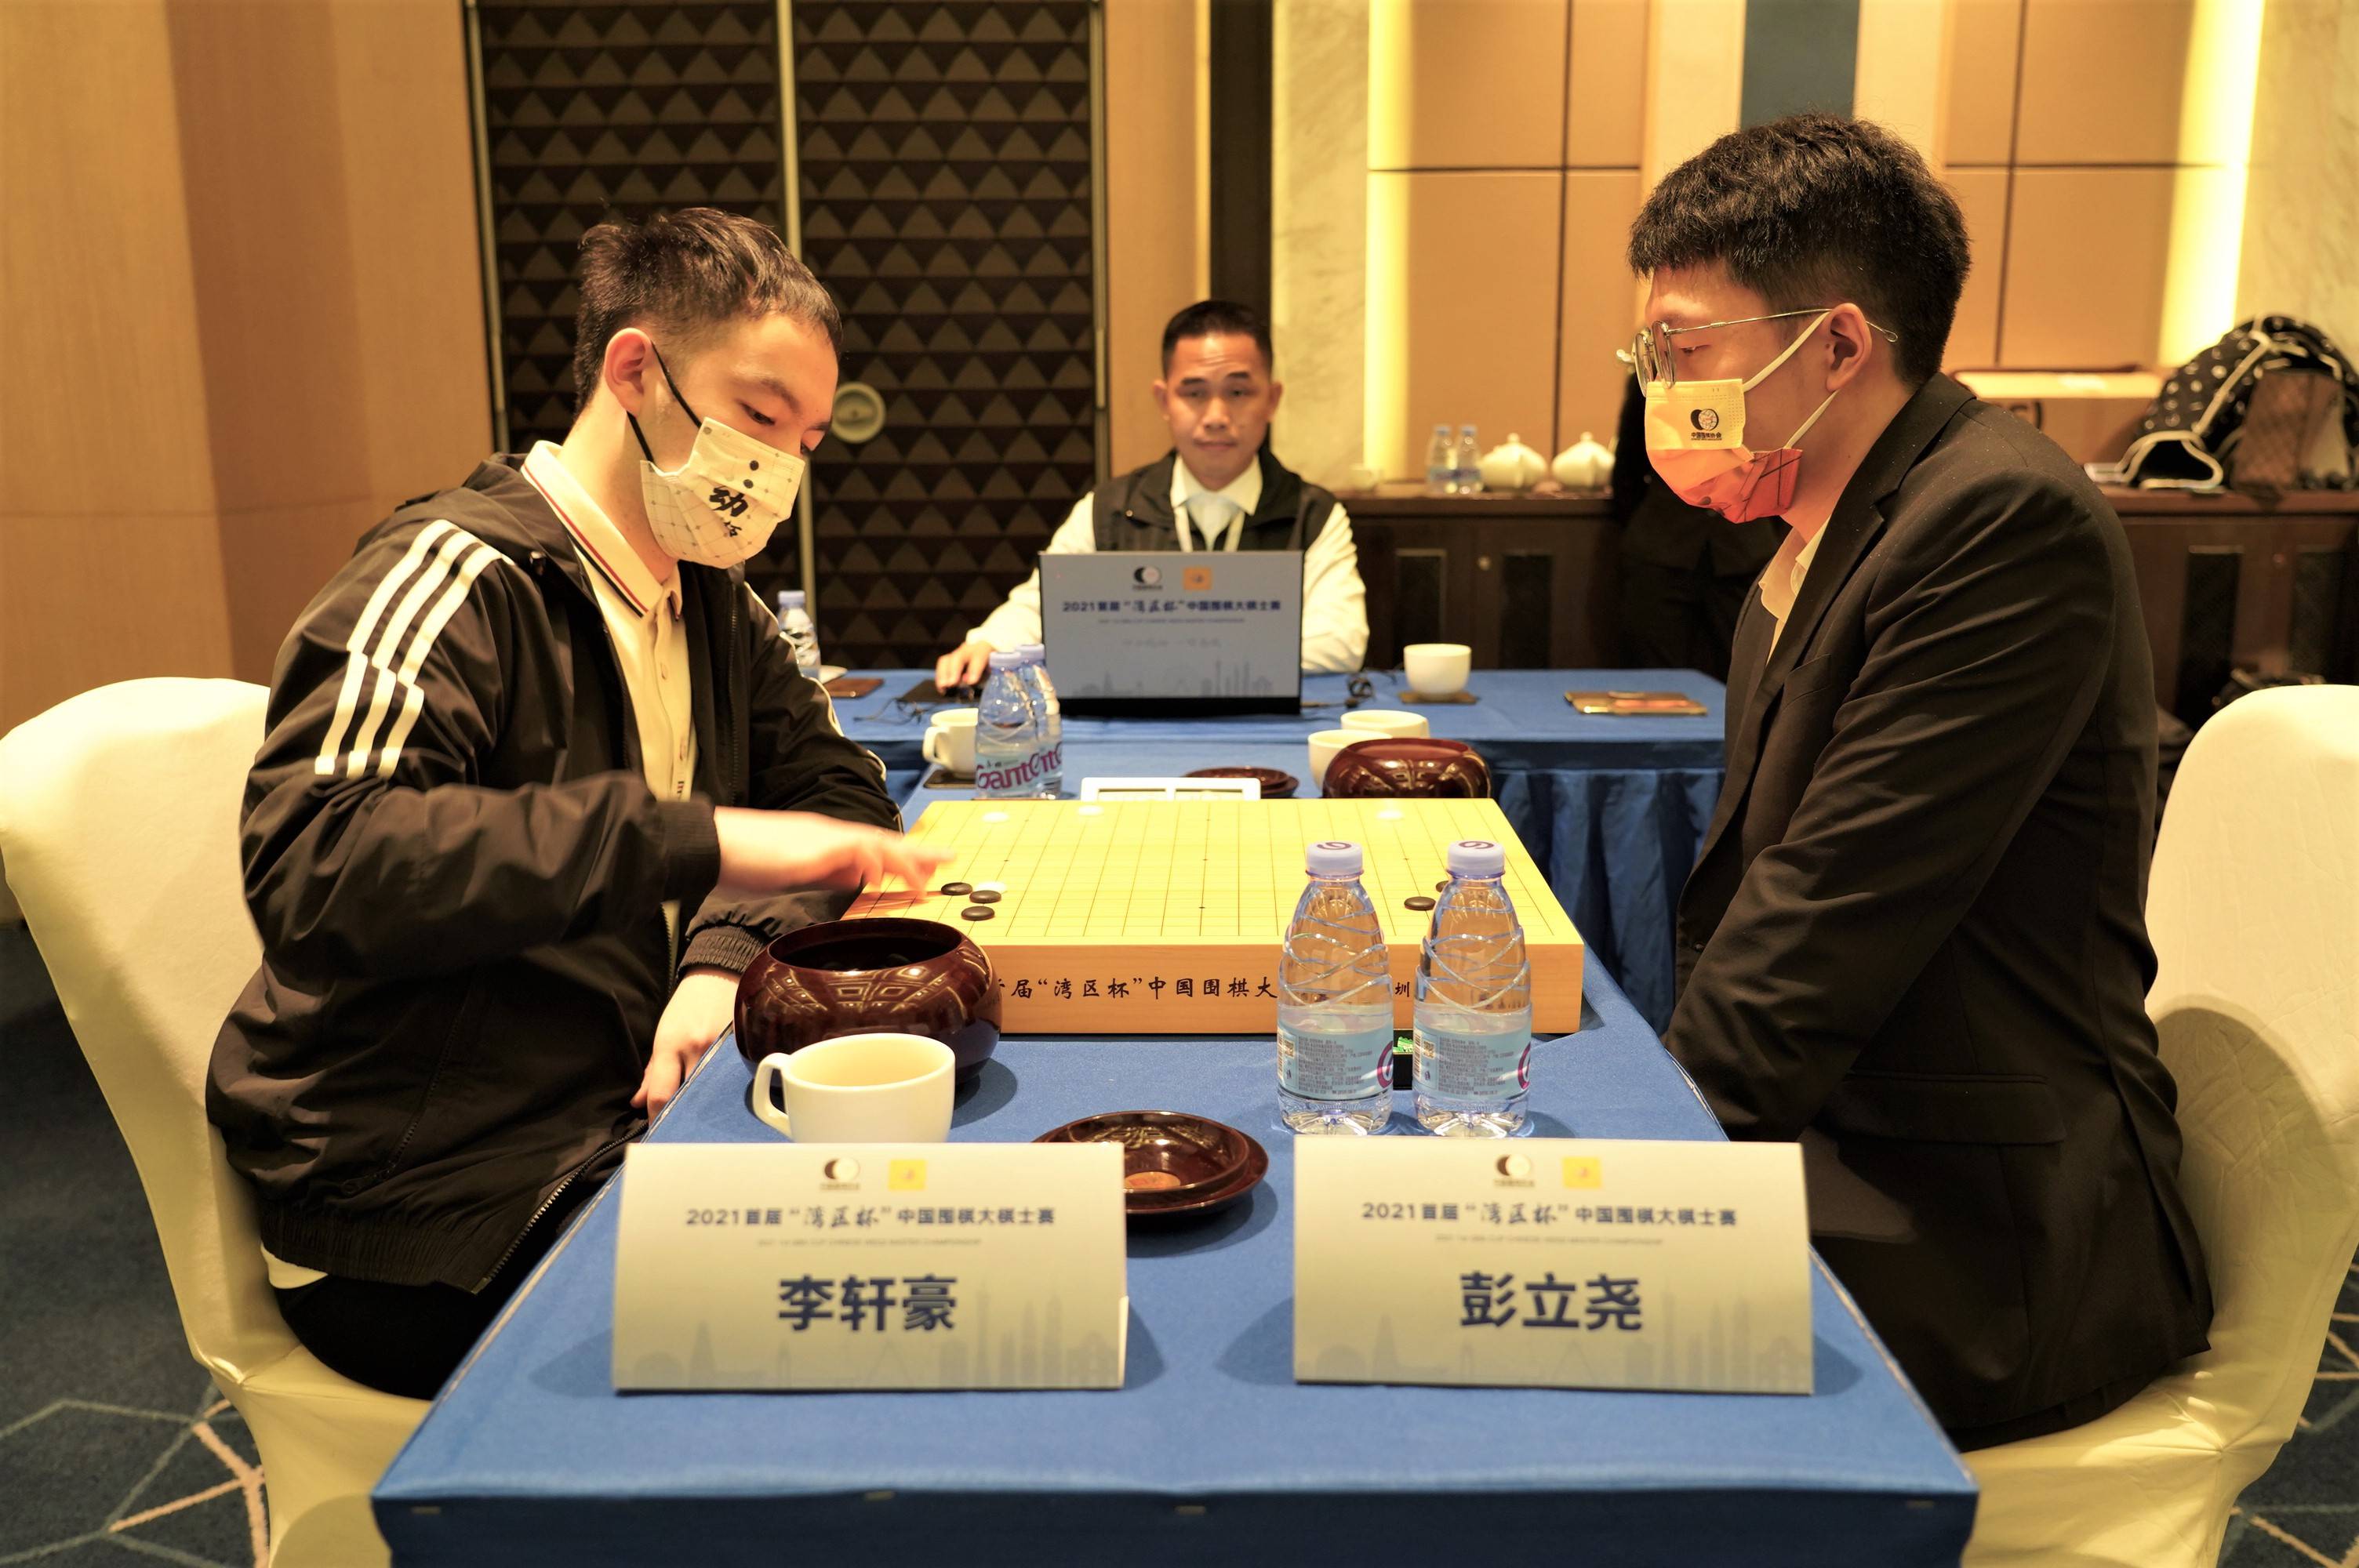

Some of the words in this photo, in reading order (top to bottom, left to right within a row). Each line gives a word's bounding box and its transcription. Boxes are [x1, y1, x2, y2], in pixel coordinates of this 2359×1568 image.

[998, 976, 1278, 1000] 届“湾区杯”中国围棋大
[778, 1273, 958, 1333] 李轩豪
[1459, 1271, 1644, 1332] 彭立尧
